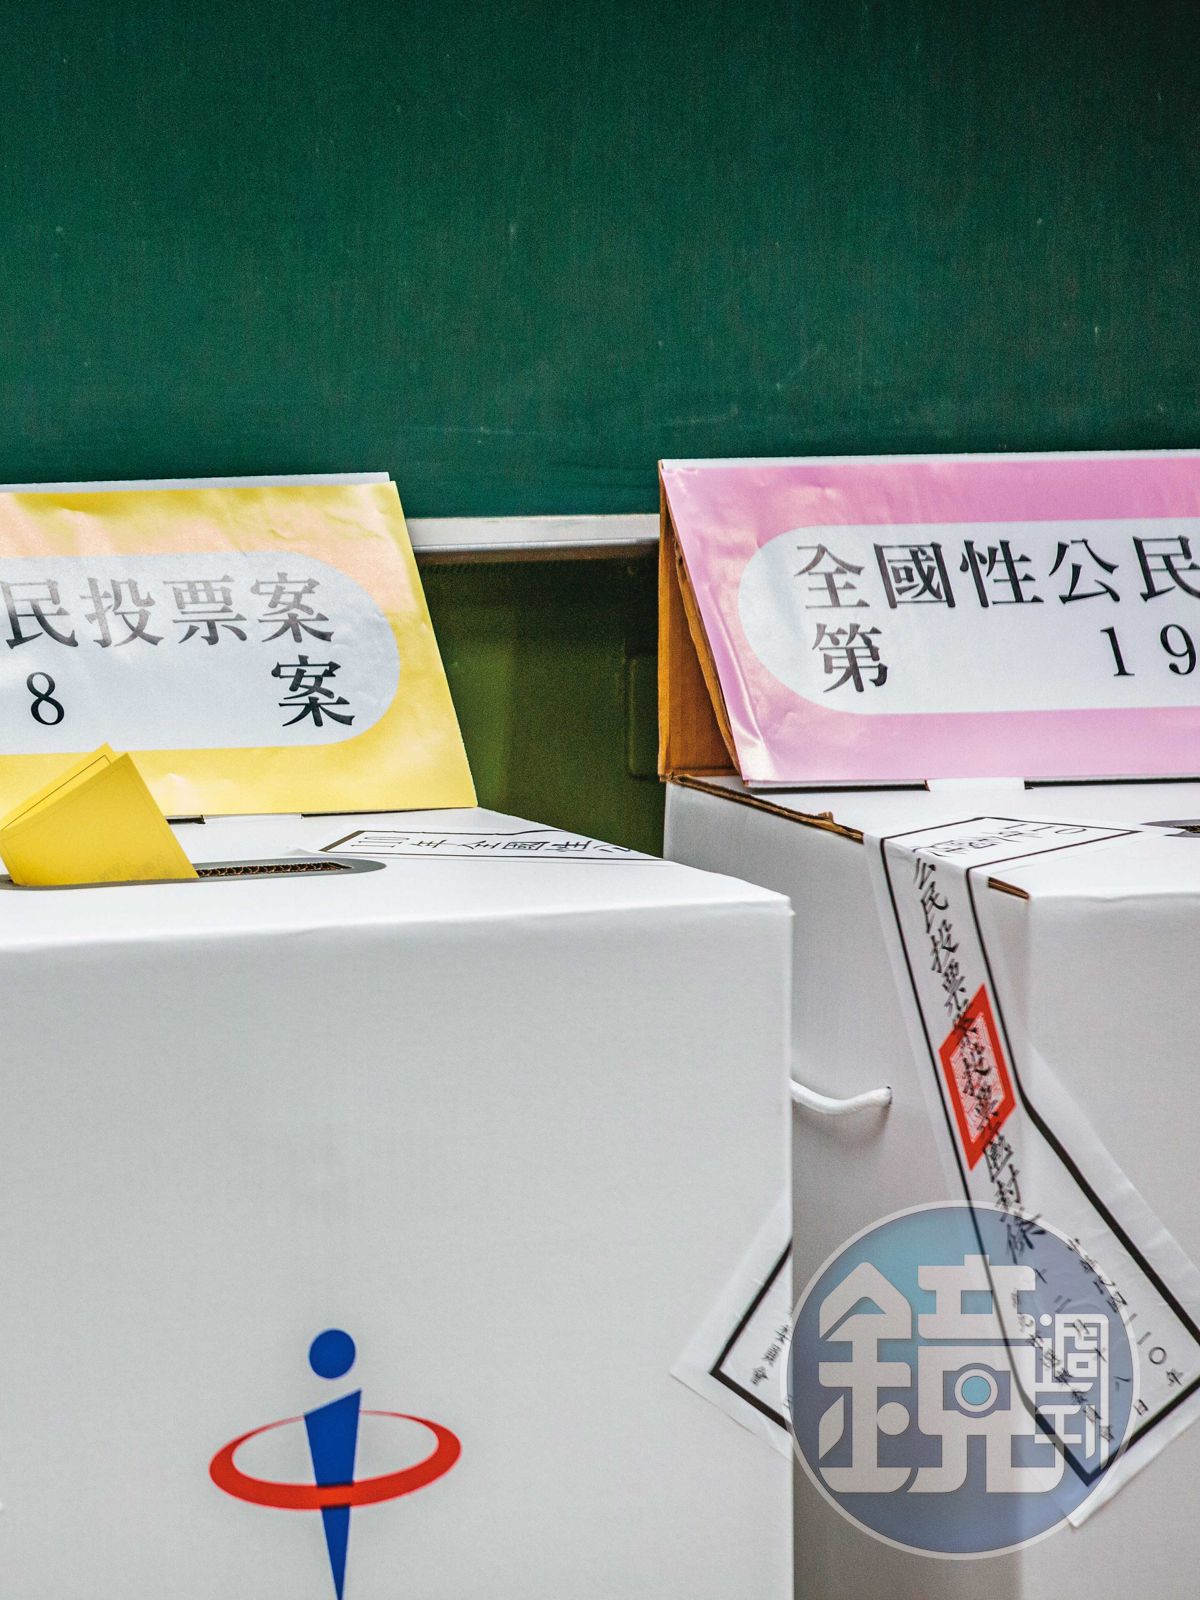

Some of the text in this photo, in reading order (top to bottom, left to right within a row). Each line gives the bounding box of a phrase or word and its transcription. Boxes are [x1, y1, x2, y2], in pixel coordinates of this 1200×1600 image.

[796, 535, 1200, 609] 全國性公民
[270, 655, 355, 729] 案
[812, 623, 889, 693] 第
